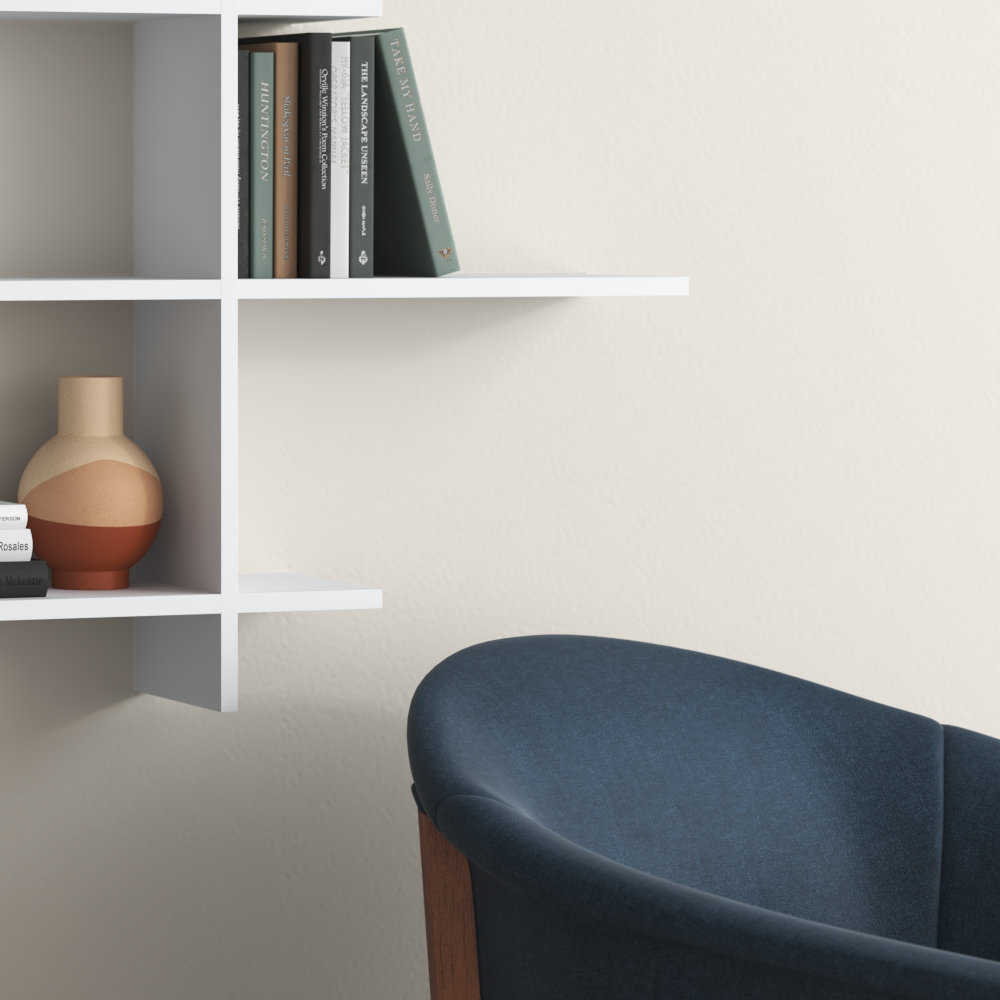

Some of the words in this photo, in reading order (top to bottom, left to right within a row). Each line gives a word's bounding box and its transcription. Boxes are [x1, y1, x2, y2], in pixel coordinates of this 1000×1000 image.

[390, 38, 406, 75] TAKE
[320, 68, 329, 95] Orville
[399, 78, 412, 98] MY
[260, 82, 269, 181] HUNTINGTON
[320, 94, 329, 132] Winston's
[360, 84, 369, 143] LANDSCAPE
[405, 102, 421, 142] HAND
[320, 132, 328, 153] Poem
[320, 153, 328, 190] Collection
[360, 145, 368, 184] UNSEEN
